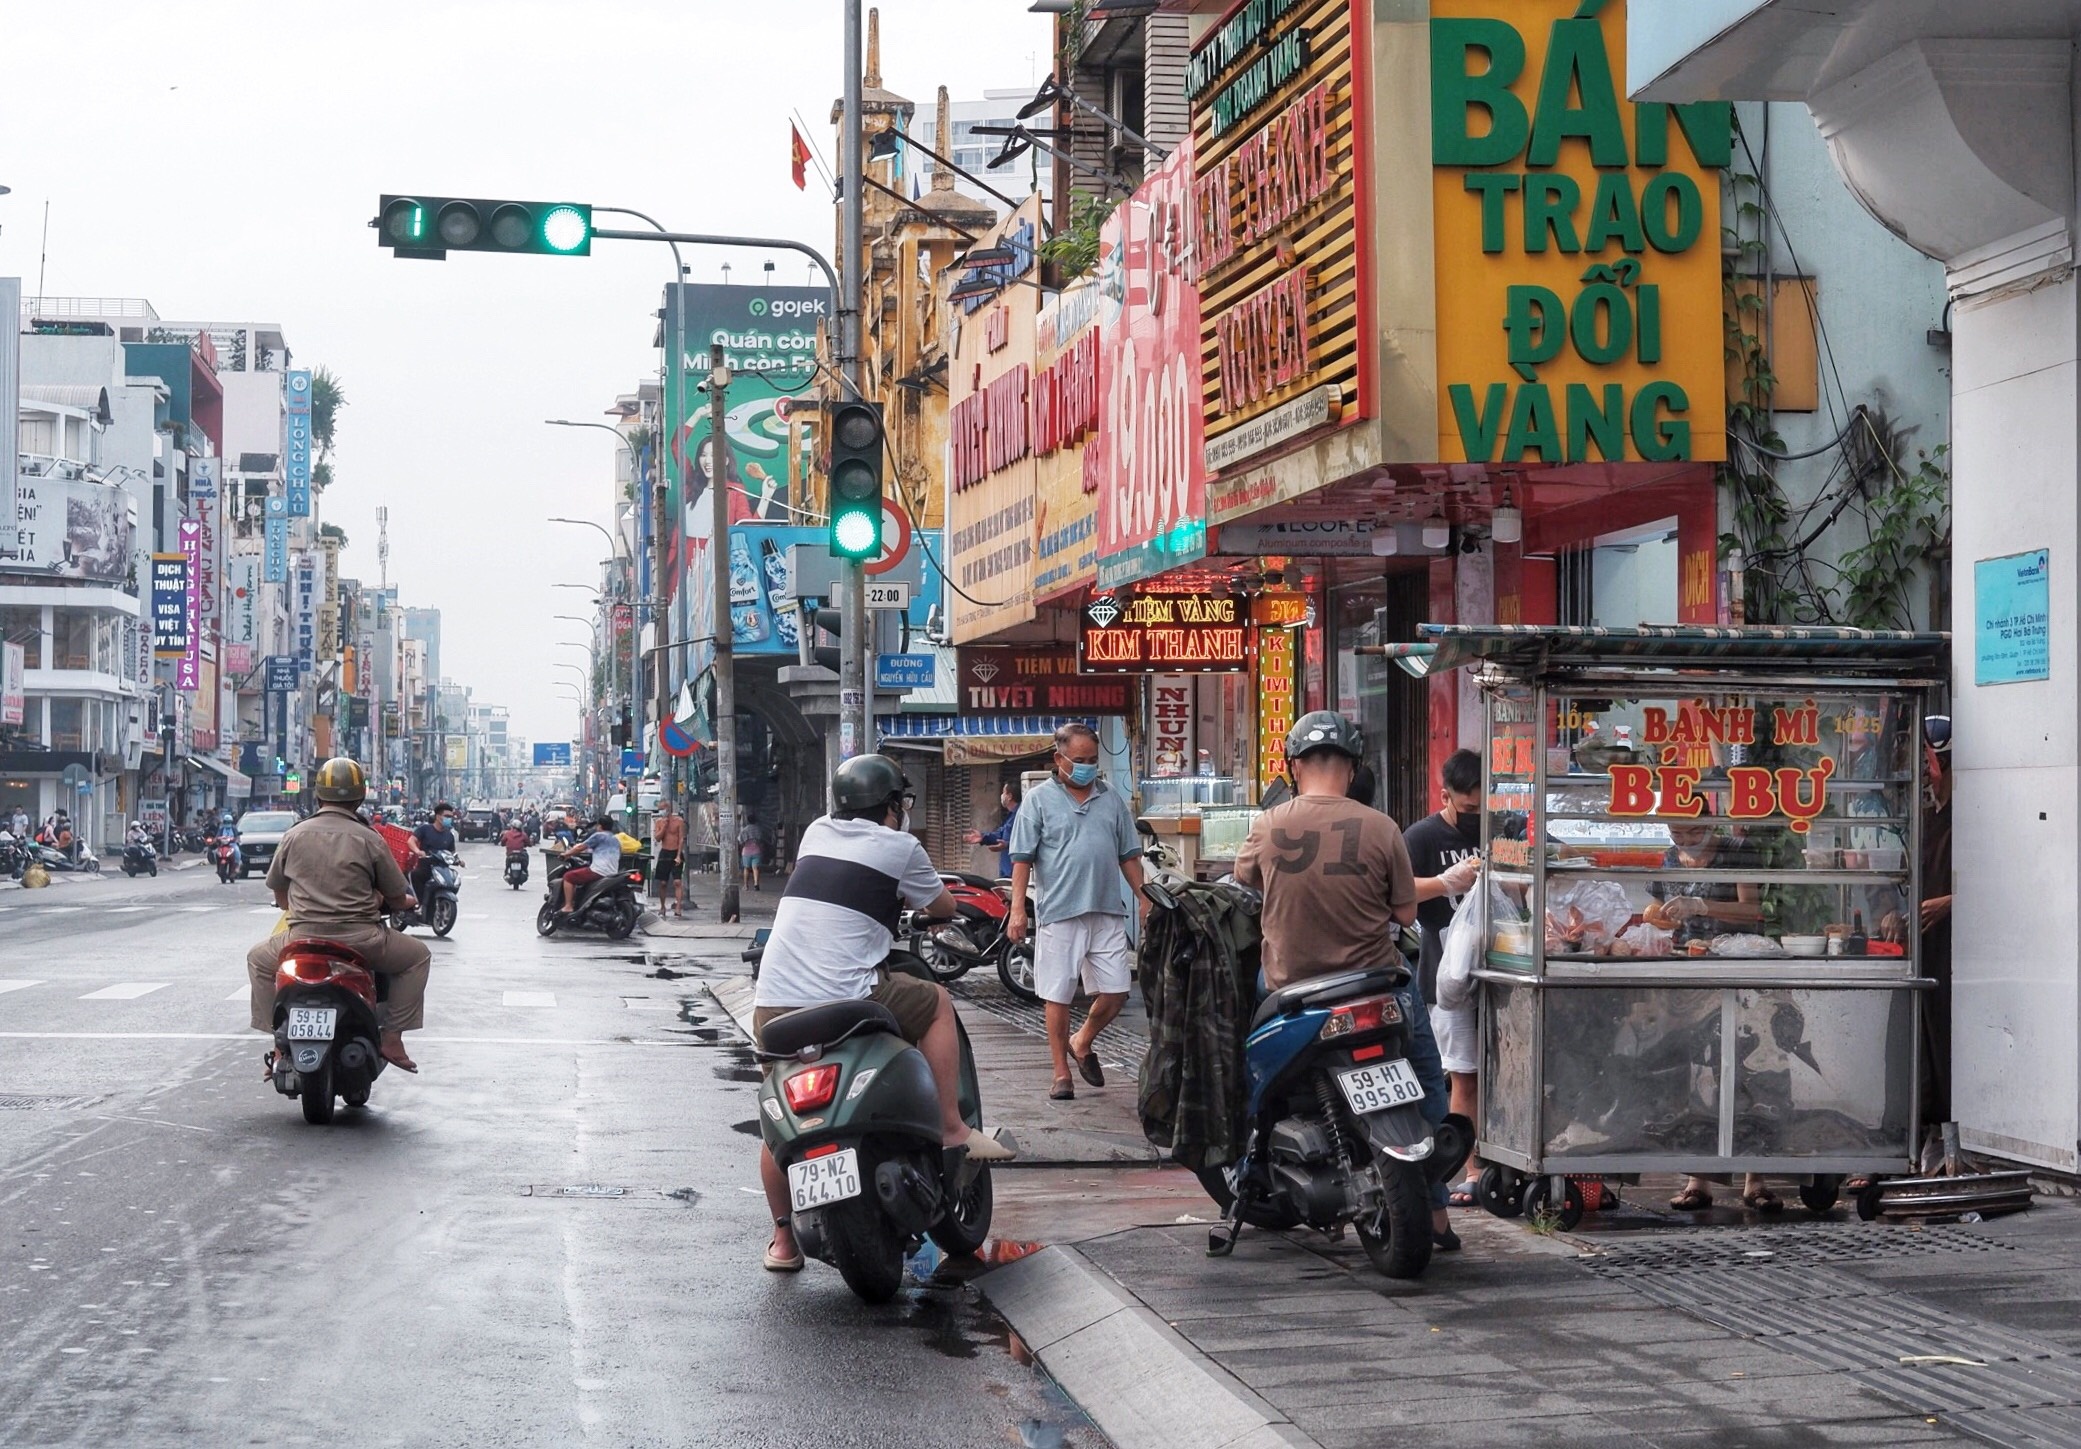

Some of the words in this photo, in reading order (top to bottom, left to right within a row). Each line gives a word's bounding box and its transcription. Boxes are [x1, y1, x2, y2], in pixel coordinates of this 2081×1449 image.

[1234, 53, 1268, 119] DOANH
[1270, 28, 1301, 88] VÀNG
[1239, 81, 1329, 246] THANH
[1464, 171, 1703, 254] TRAO
[771, 298, 826, 317] gojek
[1502, 258, 1661, 365] ĐỔI
[712, 329, 772, 349] Quán
[777, 331, 817, 349] còn
[684, 353, 738, 371] Mìh
[743, 354, 786, 372] còn
[792, 355, 816, 373] Fr
[1447, 362, 1691, 463] VÀNG
[292, 417, 305, 462] LONG
[1108, 336, 1190, 545] 19.000
[191, 488, 217, 498] THUỐC
[195, 477, 212, 487] NHÀ
[18, 548, 36, 561] IA
[1258, 538, 1307, 548] Aluminum
[157, 564, 182, 578] DỊCH
[1685, 551, 1709, 618] DỊCH
[154, 580, 186, 592] THUẬT
[730, 586, 756, 597] Comfort
[771, 592, 787, 603] Com
[158, 604, 181, 615] VISA
[1123, 595, 1174, 627] TIỆM
[1177, 594, 1235, 623] VÀNG
[158, 619, 180, 632] VIỆT
[168, 634, 185, 646] TÍN
[1088, 629, 1141, 661] KIM
[1146, 629, 1243, 660] THANH
[182, 650, 195, 687] USA
[890, 658, 923, 668] ĐƯỜNG
[1015, 654, 1052, 677] TIỆM
[1057, 654, 1077, 674] VÀ
[1265, 636, 1289, 692] KIM
[968, 680, 1036, 709] TUYẾT
[1049, 685, 1125, 708] NHUNG
[1155, 687, 1189, 751] NHUN
[1643, 697, 1756, 746] BÁNH
[1773, 699, 1820, 746] MÌ
[1268, 698, 1288, 784] THAN
[1607, 745, 1704, 819] BÉ
[1727, 755, 1835, 834] BỰ
[291, 1024, 331, 1038] 058.44
[296, 1010, 328, 1024] 59-E1
[1351, 1064, 1403, 1090] 59-H1
[1353, 1080, 1419, 1111] 995.80
[799, 1156, 848, 1186] 79-N2
[796, 1175, 857, 1207] 644.10
